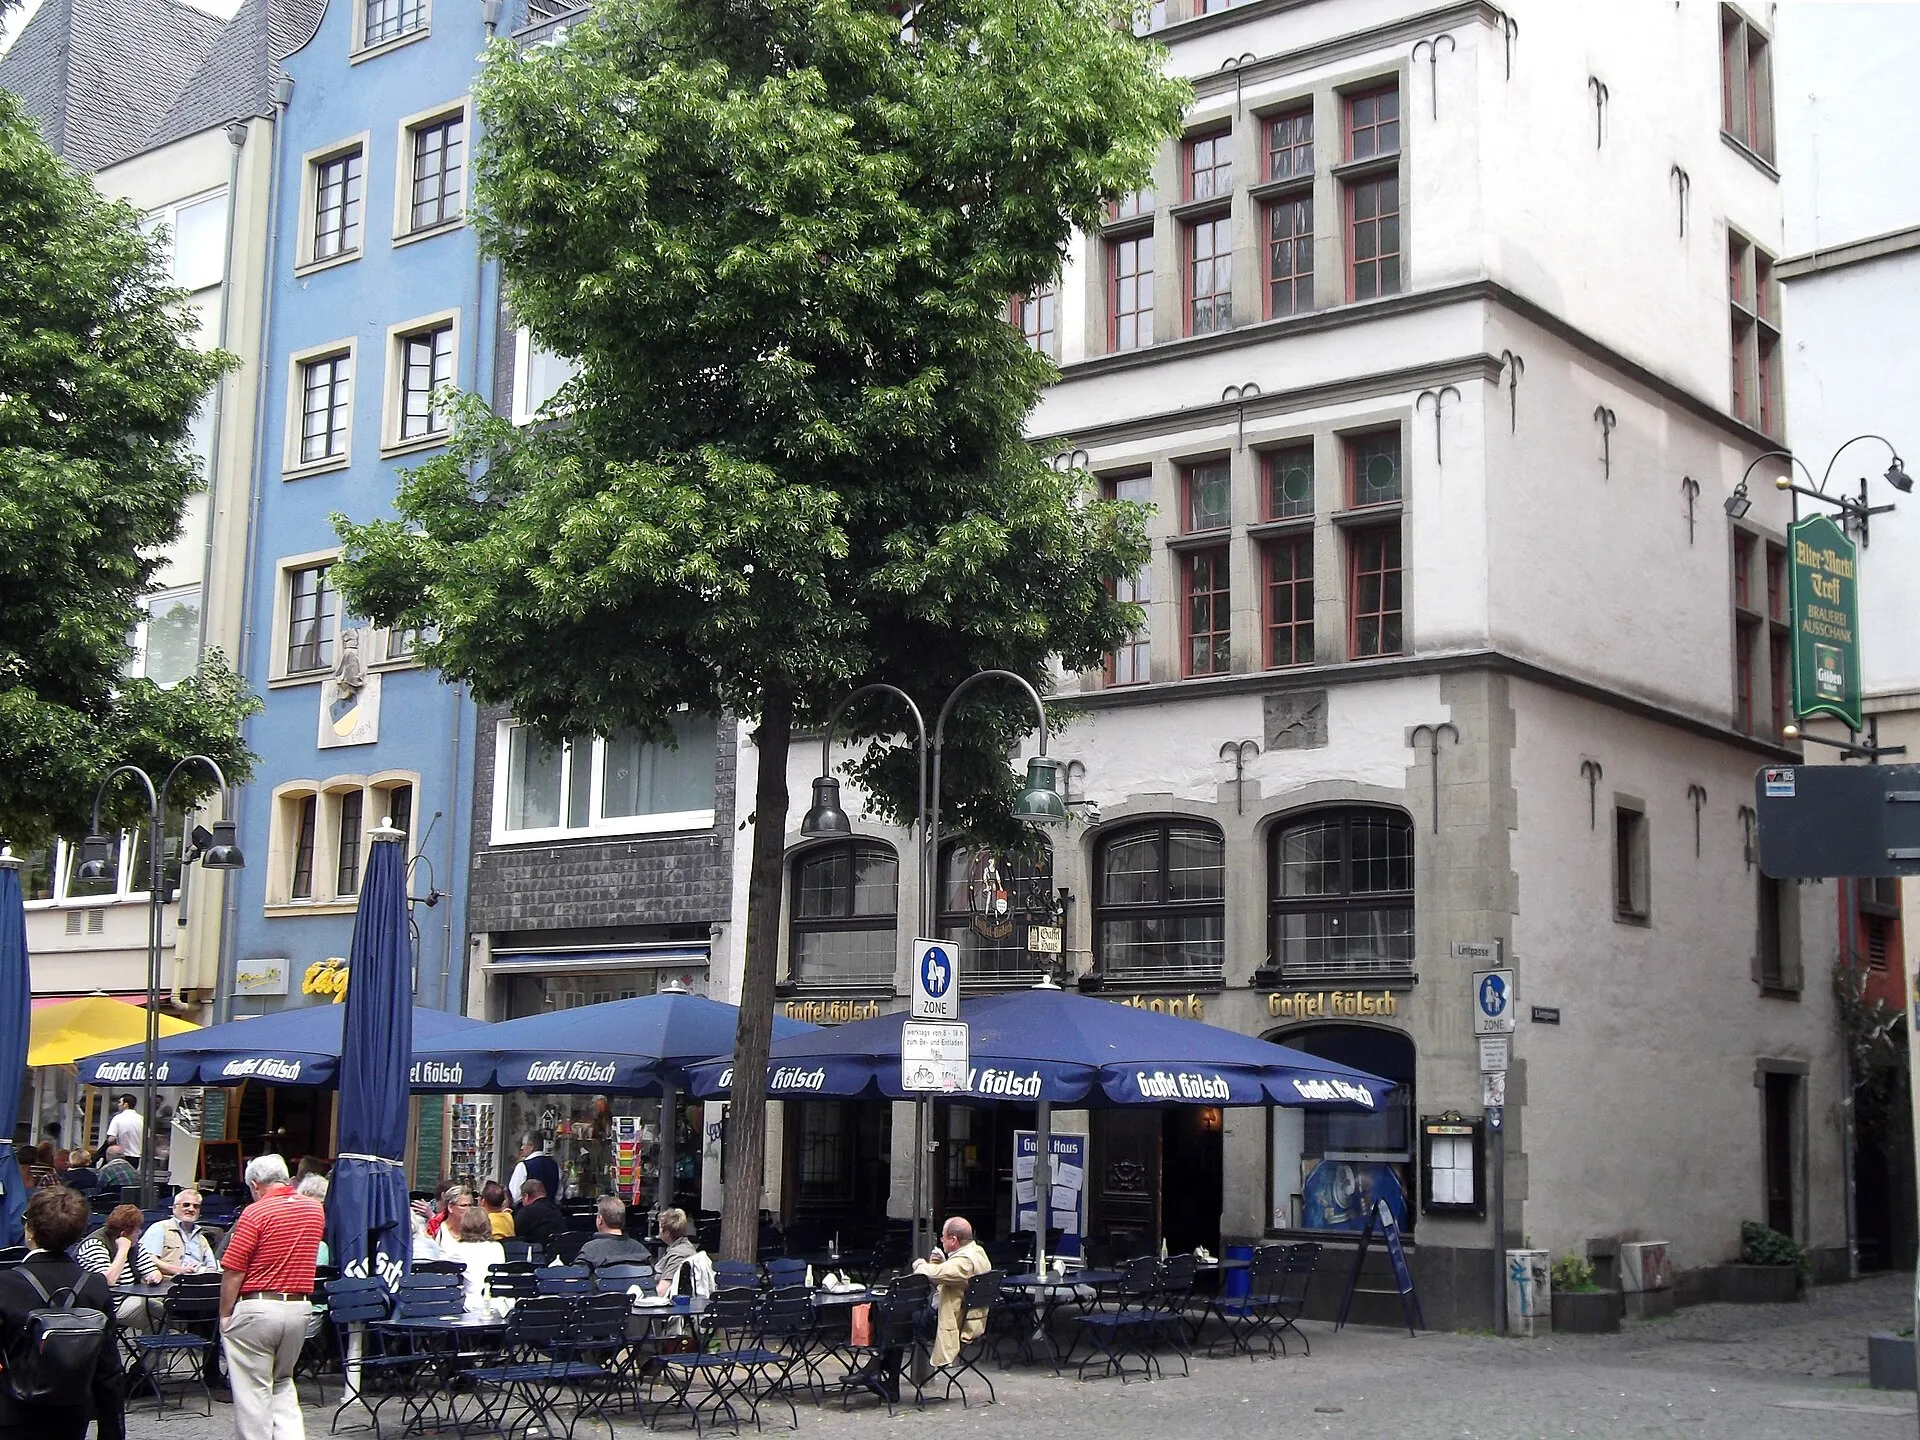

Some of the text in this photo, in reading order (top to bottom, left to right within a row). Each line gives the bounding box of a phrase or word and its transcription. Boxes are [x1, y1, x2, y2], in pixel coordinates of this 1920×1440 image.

[1811, 573, 1841, 605] Treff
[1808, 604, 1847, 627] BRAUEREI
[1803, 619, 1853, 644] AUSSCHANK
[1818, 667, 1842, 685] Gilden
[924, 1001, 947, 1014] ZONE
[1268, 990, 1397, 1021] Gaffel Kölsch
[906, 1029, 930, 1037] werktags
[1483, 1019, 1504, 1031] ZONE
[941, 1038, 964, 1046] Entladen
[95, 1061, 134, 1082] Gaffel
[222, 1058, 301, 1080] Gaffel Kölsch
[423, 1061, 463, 1085] Kölsch
[527, 1060, 616, 1084] Gaffel Kölsch
[771, 1066, 826, 1090] Kölsch
[979, 1068, 1042, 1098] Kölsch
[1137, 1071, 1230, 1101] Gaffel Kölsch
[1292, 1079, 1340, 1100] Gaffel
[1331, 1079, 1375, 1108] Kölsch
[1054, 1140, 1079, 1154] Haus
